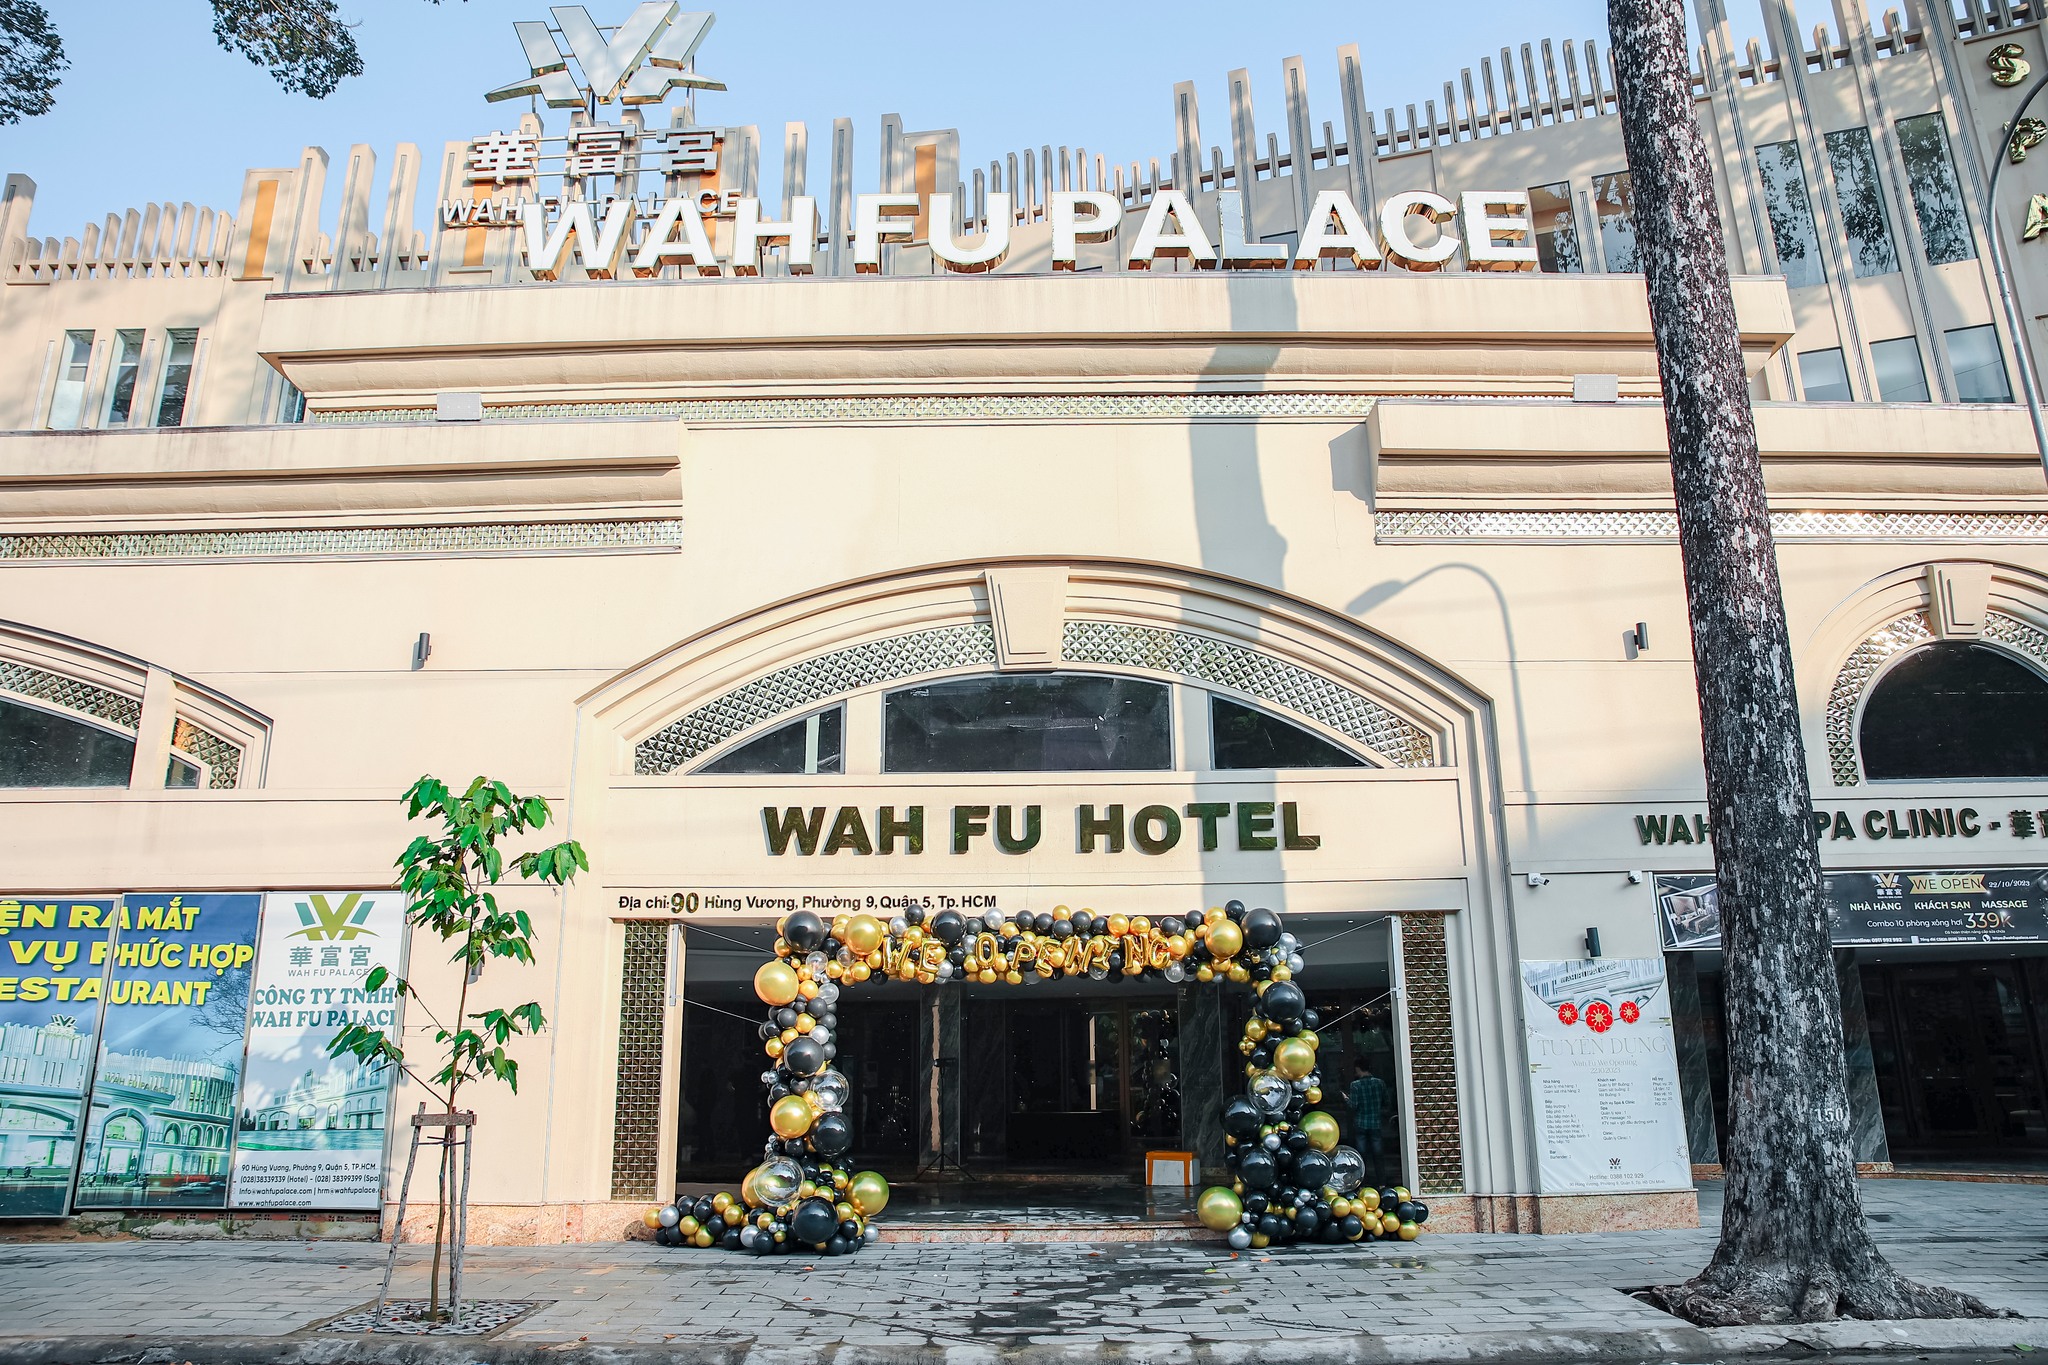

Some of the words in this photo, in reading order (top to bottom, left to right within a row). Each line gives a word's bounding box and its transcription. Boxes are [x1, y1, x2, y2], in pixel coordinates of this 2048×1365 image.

[467, 121, 726, 185] 華富宮
[442, 197, 525, 224] WAH
[599, 189, 741, 217] PALCE
[523, 196, 815, 280] WAH
[855, 192, 1010, 274] FU
[1052, 190, 1538, 272] PALACE
[762, 805, 923, 855] WAH
[953, 804, 1041, 854] FU
[1076, 801, 1321, 854] HOTEL
[1813, 811, 1856, 840] PA
[1863, 807, 1981, 840] CLINIC
[1913, 878, 1937, 890] WE
[1940, 878, 1980, 890] OPEN
[1988, 878, 2030, 888] 22/10/2023
[68, 905, 131, 930] RA
[137, 896, 200, 930] MẮT
[619, 896, 640, 911] Địa
[670, 892, 699, 913] 90
[705, 896, 741, 911] Hùng
[746, 896, 798, 911] Vương,
[803, 894, 860, 911] Phường
[866, 896, 878, 910] 9,
[880, 895, 918, 910] Quận
[922, 896, 935, 909] 5,
[938, 895, 959, 909] Tp.
[962, 895, 996, 908] HCM
[1850, 901, 1871, 911] NHÀ
[1873, 901, 1902, 911] HÀNG
[1914, 900, 1949, 910] KHÁCH
[1950, 901, 1971, 911] SẠN
[1981, 900, 2028, 908] MASSAGE
[1867, 920, 1894, 928] Combo
[1906, 920, 1930, 928] phòng
[8, 940, 79, 972] VỤ
[89, 937, 184, 968] PHỨC
[188, 942, 254, 976] HỢP
[289, 945, 371, 967] 華富宮
[882, 936, 943, 974] WE
[974, 932, 1171, 974] OPENING
[288, 969, 310, 977] WAH
[329, 968, 368, 976] PALACE
[254, 984, 305, 1005] CÔNG
[310, 988, 336, 1004] TY
[252, 1010, 292, 1028] WAH
[296, 1010, 322, 1027] FU
[1610, 1036, 1666, 1057] DỤNG
[251, 1164, 268, 1173] Hùng
[318, 1163, 324, 1171] 9,
[344, 1163, 350, 1171] 5,
[238, 1199, 312, 1207] www.wahfupalace.com
